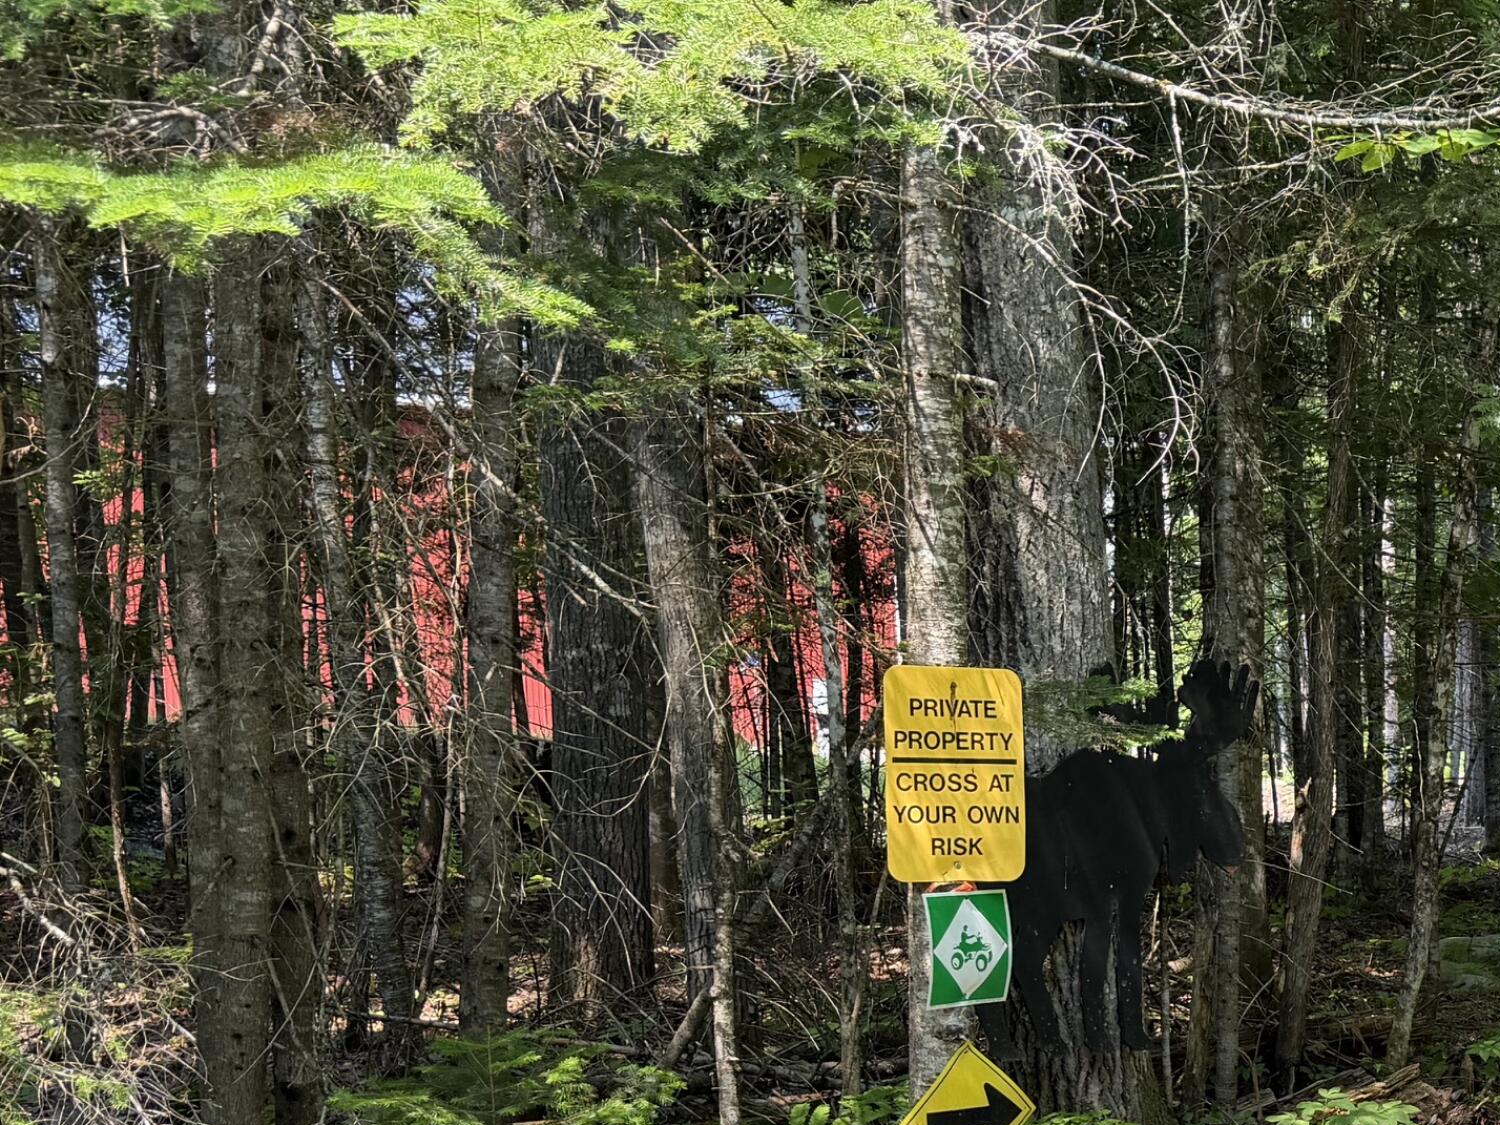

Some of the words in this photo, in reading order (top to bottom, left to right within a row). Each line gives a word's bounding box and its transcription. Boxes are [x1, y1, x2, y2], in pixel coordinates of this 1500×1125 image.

[909, 698, 997, 719] PRIVATE
[893, 730, 1013, 751] PROPERTY
[896, 772, 978, 792] CROSS
[989, 774, 1014, 792] AT
[893, 805, 956, 824] YOUR
[967, 806, 1020, 824] OWN
[931, 837, 983, 856] RISK
